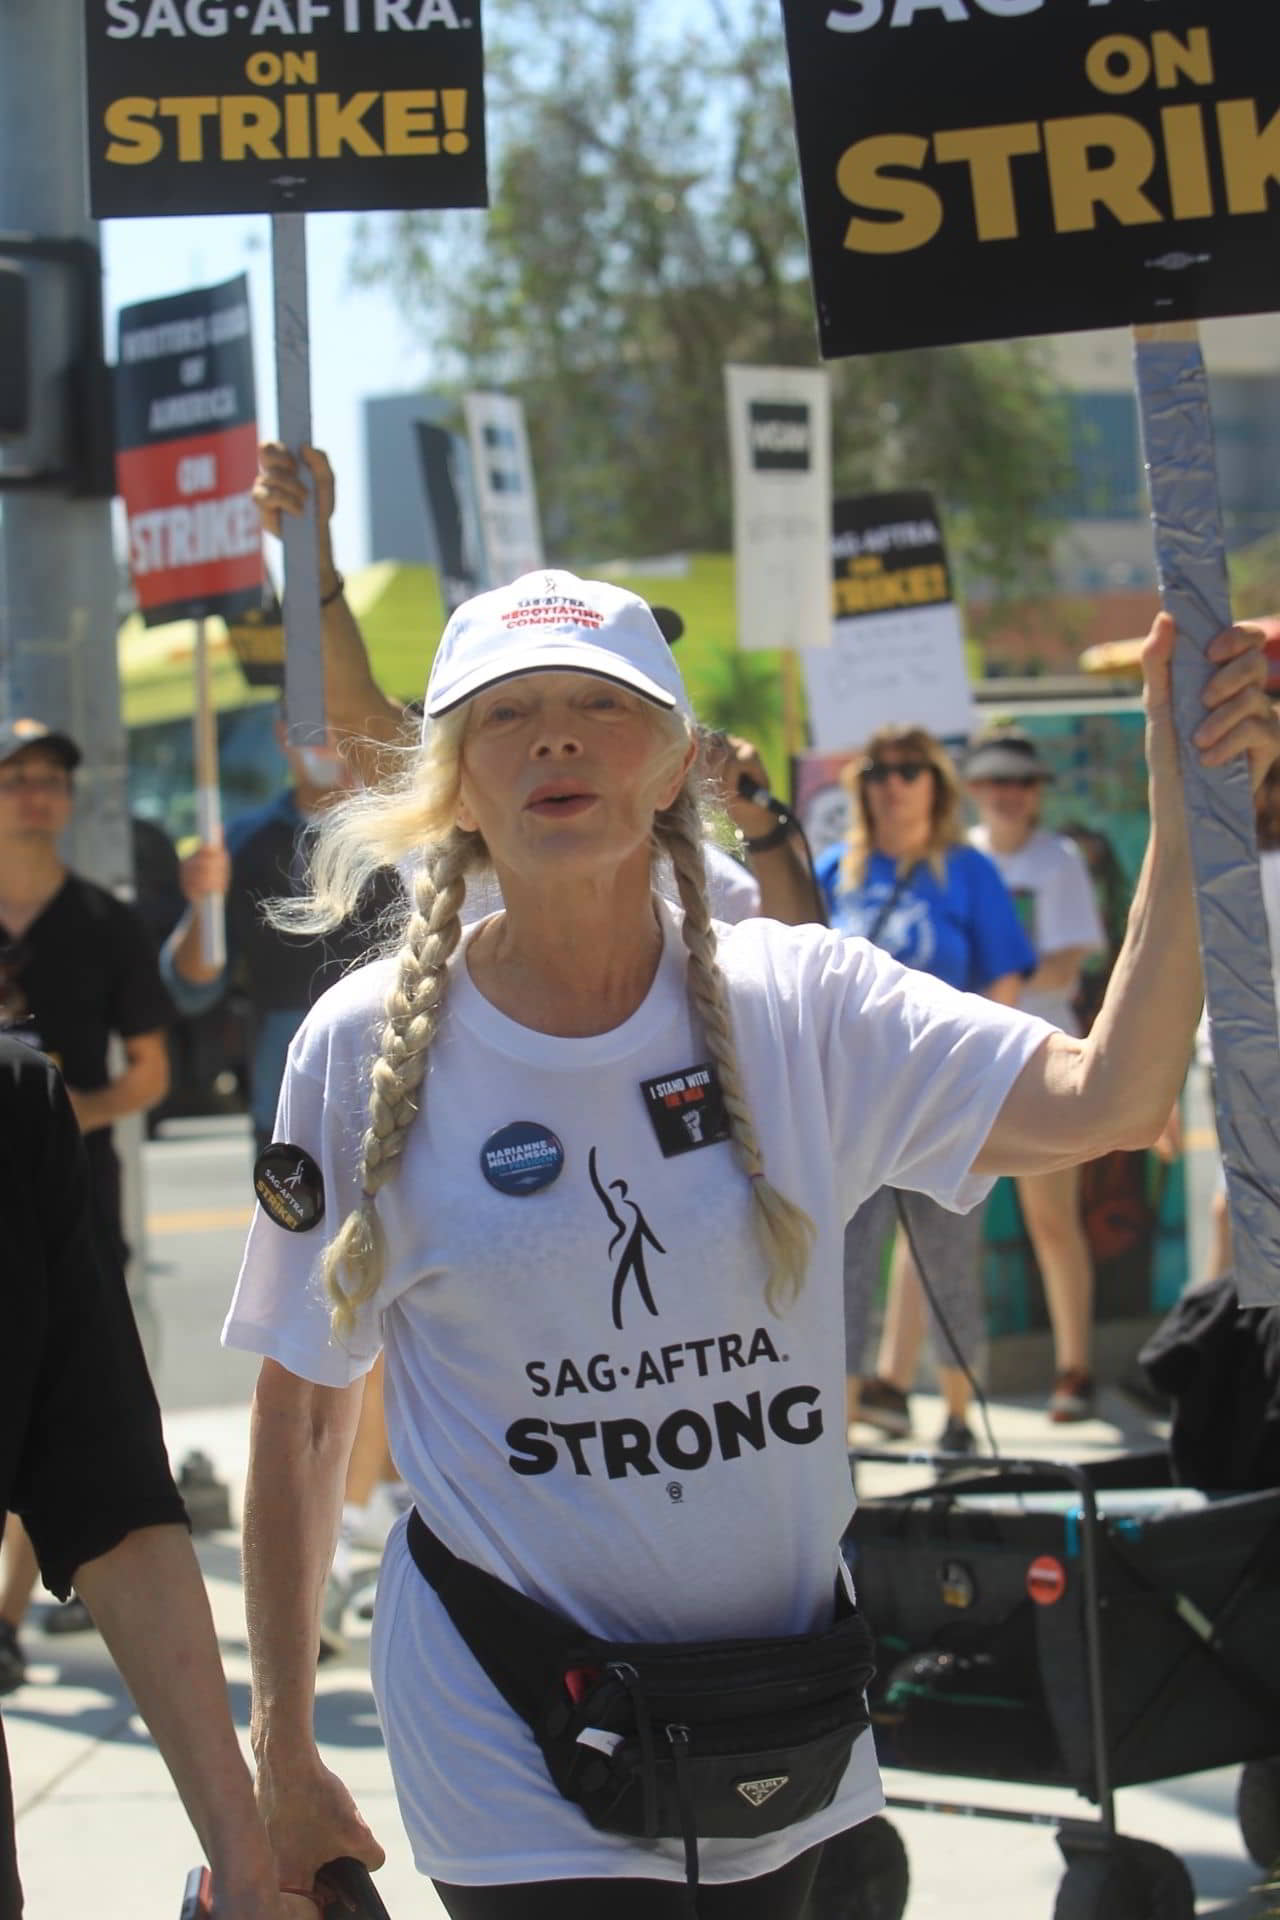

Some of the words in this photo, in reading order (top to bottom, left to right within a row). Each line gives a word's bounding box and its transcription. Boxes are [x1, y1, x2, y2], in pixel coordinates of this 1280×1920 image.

[245, 51, 318, 86] ON
[1085, 27, 1214, 95] ON
[104, 89, 469, 165] STRIKE!
[501, 606, 604, 622] NEGOTIATING
[506, 616, 600, 629] COMMITTEE
[649, 1087, 657, 1100] I
[656, 1078, 685, 1097] STAND
[685, 1070, 711, 1089] WITH
[486, 1140, 548, 1160] MARIANNE
[487, 1147, 558, 1168] WILLIAMSON
[505, 1384, 824, 1480] STRONG
